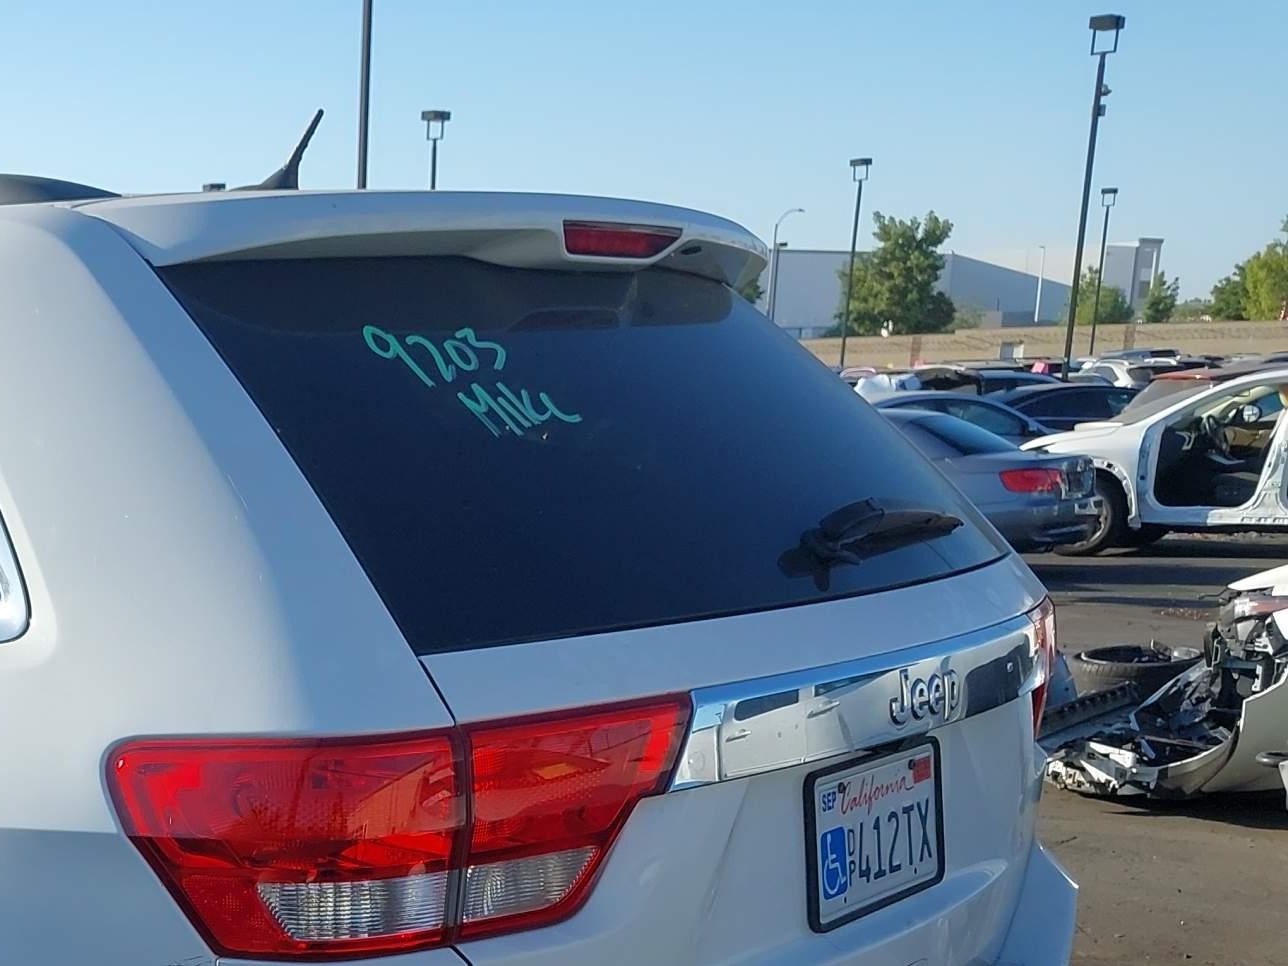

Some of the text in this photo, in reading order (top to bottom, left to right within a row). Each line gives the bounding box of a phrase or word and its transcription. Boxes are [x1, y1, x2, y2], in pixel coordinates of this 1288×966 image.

[889, 668, 960, 728] Jeep
[822, 790, 837, 813] SEP
[838, 775, 914, 816] California
